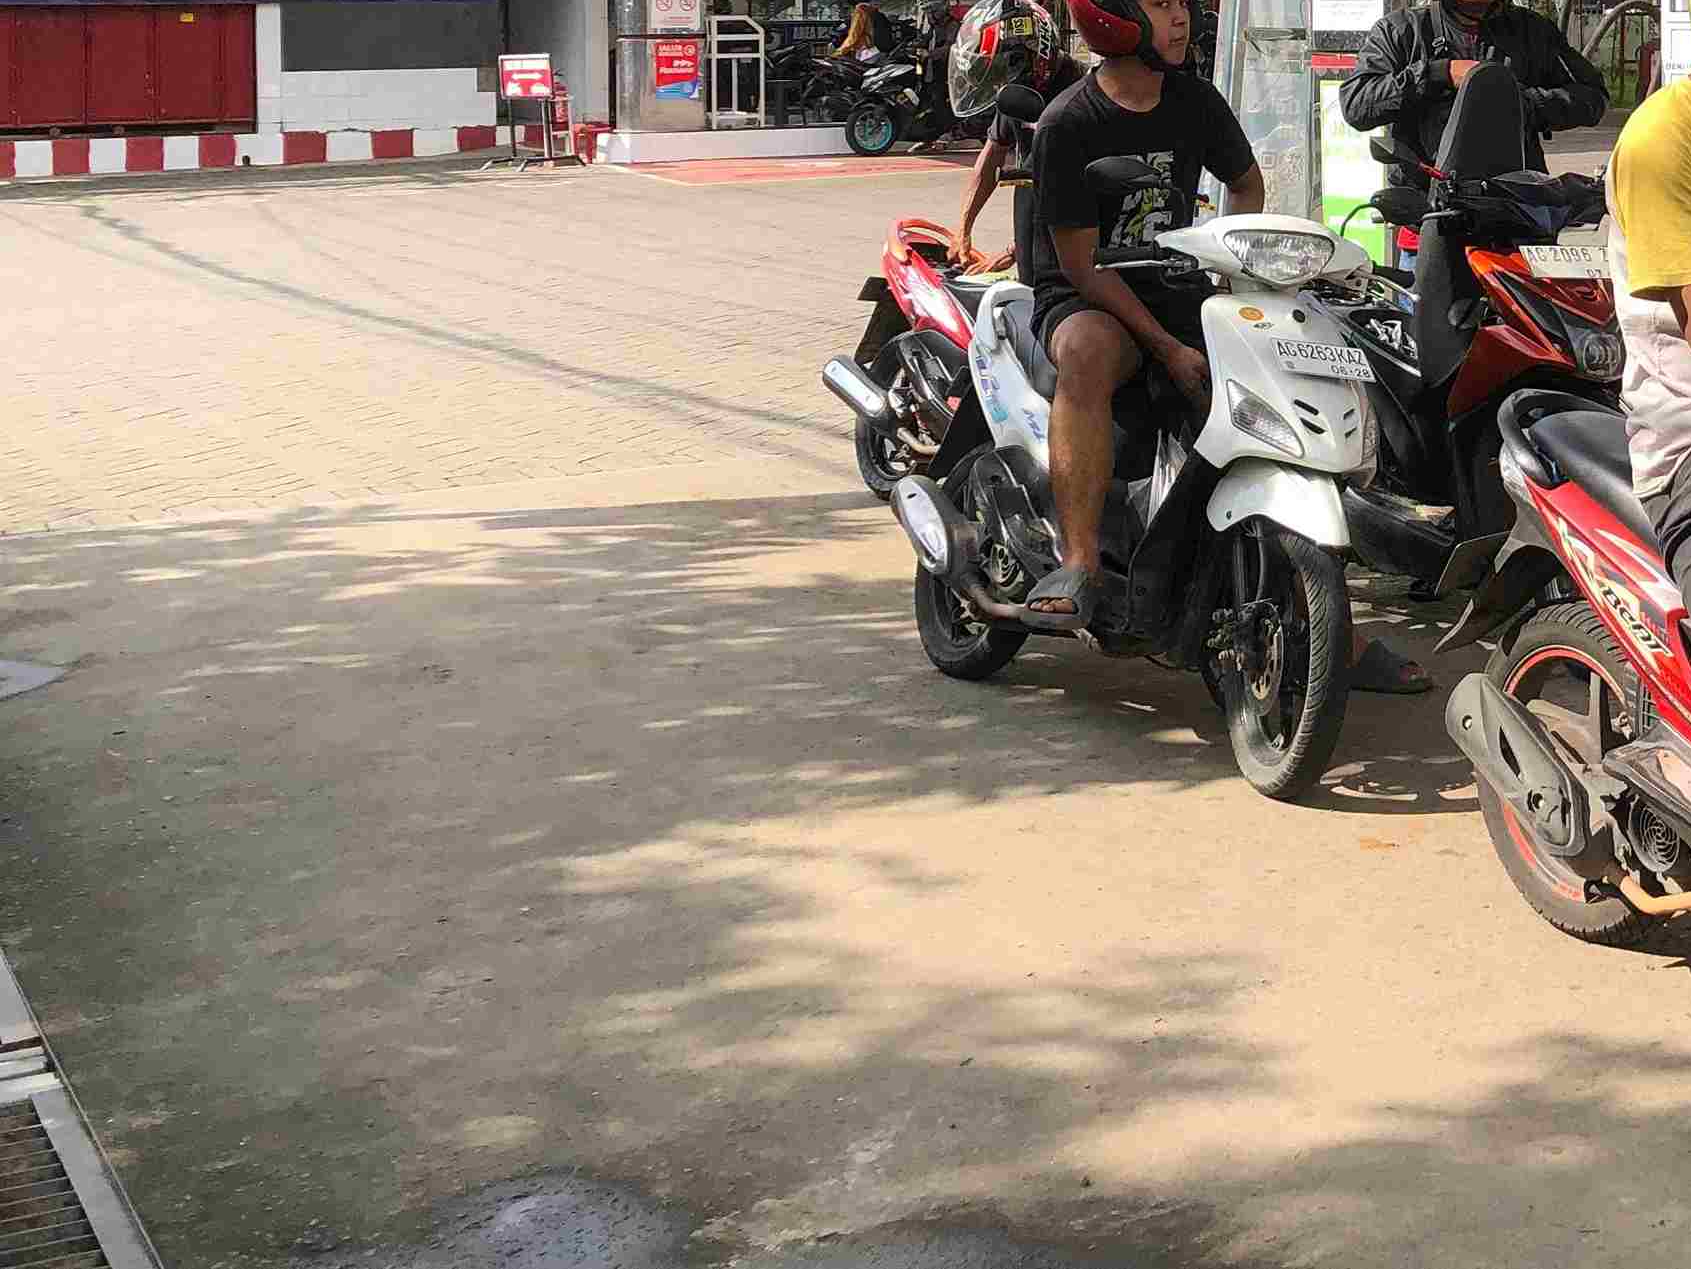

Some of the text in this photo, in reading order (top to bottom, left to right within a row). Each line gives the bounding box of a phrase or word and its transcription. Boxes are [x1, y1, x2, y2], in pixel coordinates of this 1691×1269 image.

[1550, 247, 1592, 262] 2096
[1276, 340, 1297, 357] AG
[1298, 344, 1337, 362] 6263
